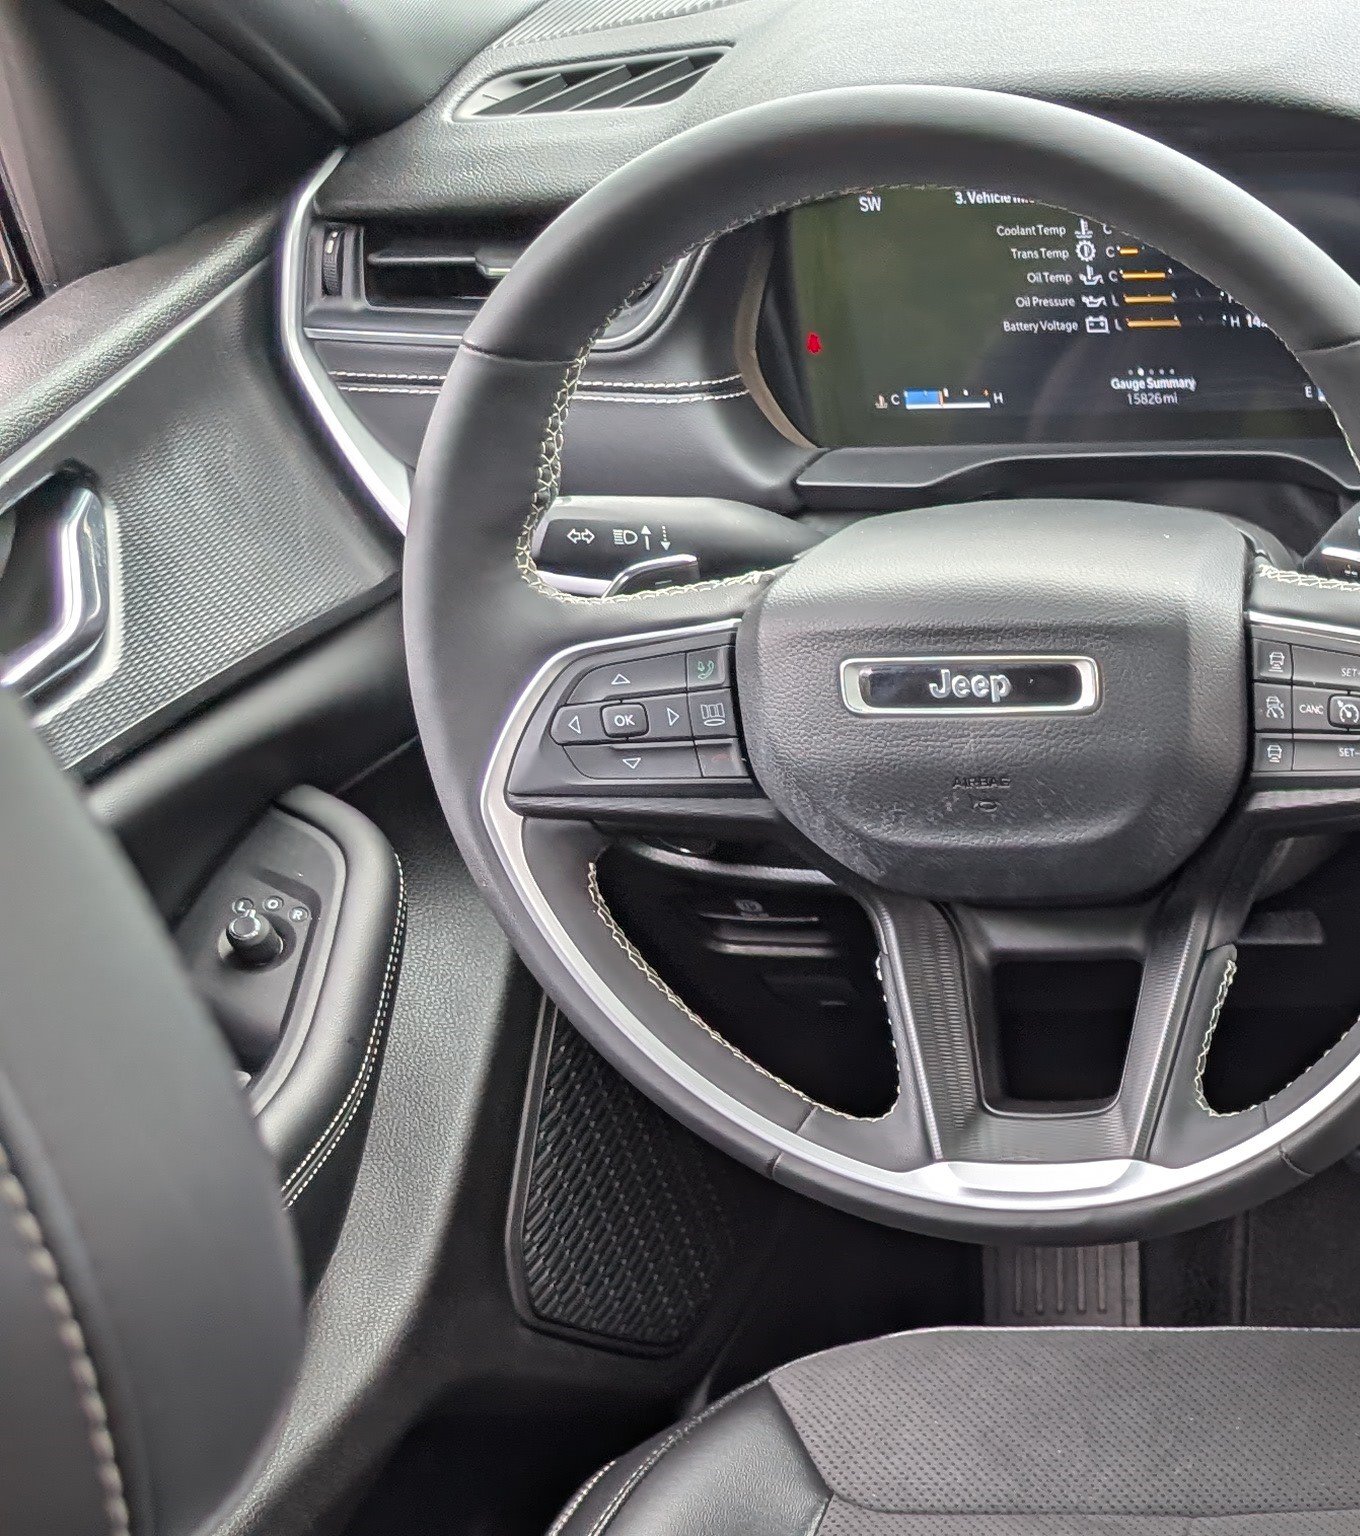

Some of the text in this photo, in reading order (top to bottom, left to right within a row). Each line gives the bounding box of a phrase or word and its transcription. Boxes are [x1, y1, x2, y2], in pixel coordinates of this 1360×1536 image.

[858, 196, 882, 212] SW
[996, 225, 1036, 236] Coolant
[1038, 225, 1067, 238] Temp
[1010, 246, 1115, 262] Trans Temp C
[1026, 272, 1043, 283] Oil
[1045, 272, 1073, 286] Temp
[1015, 296, 1030, 307] Oil
[1031, 297, 1076, 307] Pressure
[1003, 321, 1039, 333] Battery
[1041, 320, 1078, 334] Voltage
[1230, 316, 1241, 328] H
[1110, 376, 1197, 392] Gauge Summary
[993, 392, 1004, 404] H
[1126, 393, 1179, 405] 15826 mi
[929, 669, 1013, 704] Jeep
[1299, 704, 1324, 715] CANC
[614, 714, 635, 727] OK
[952, 776, 1011, 790] AIRBAG
[237, 901, 246, 912] L
[292, 909, 303, 920] R
